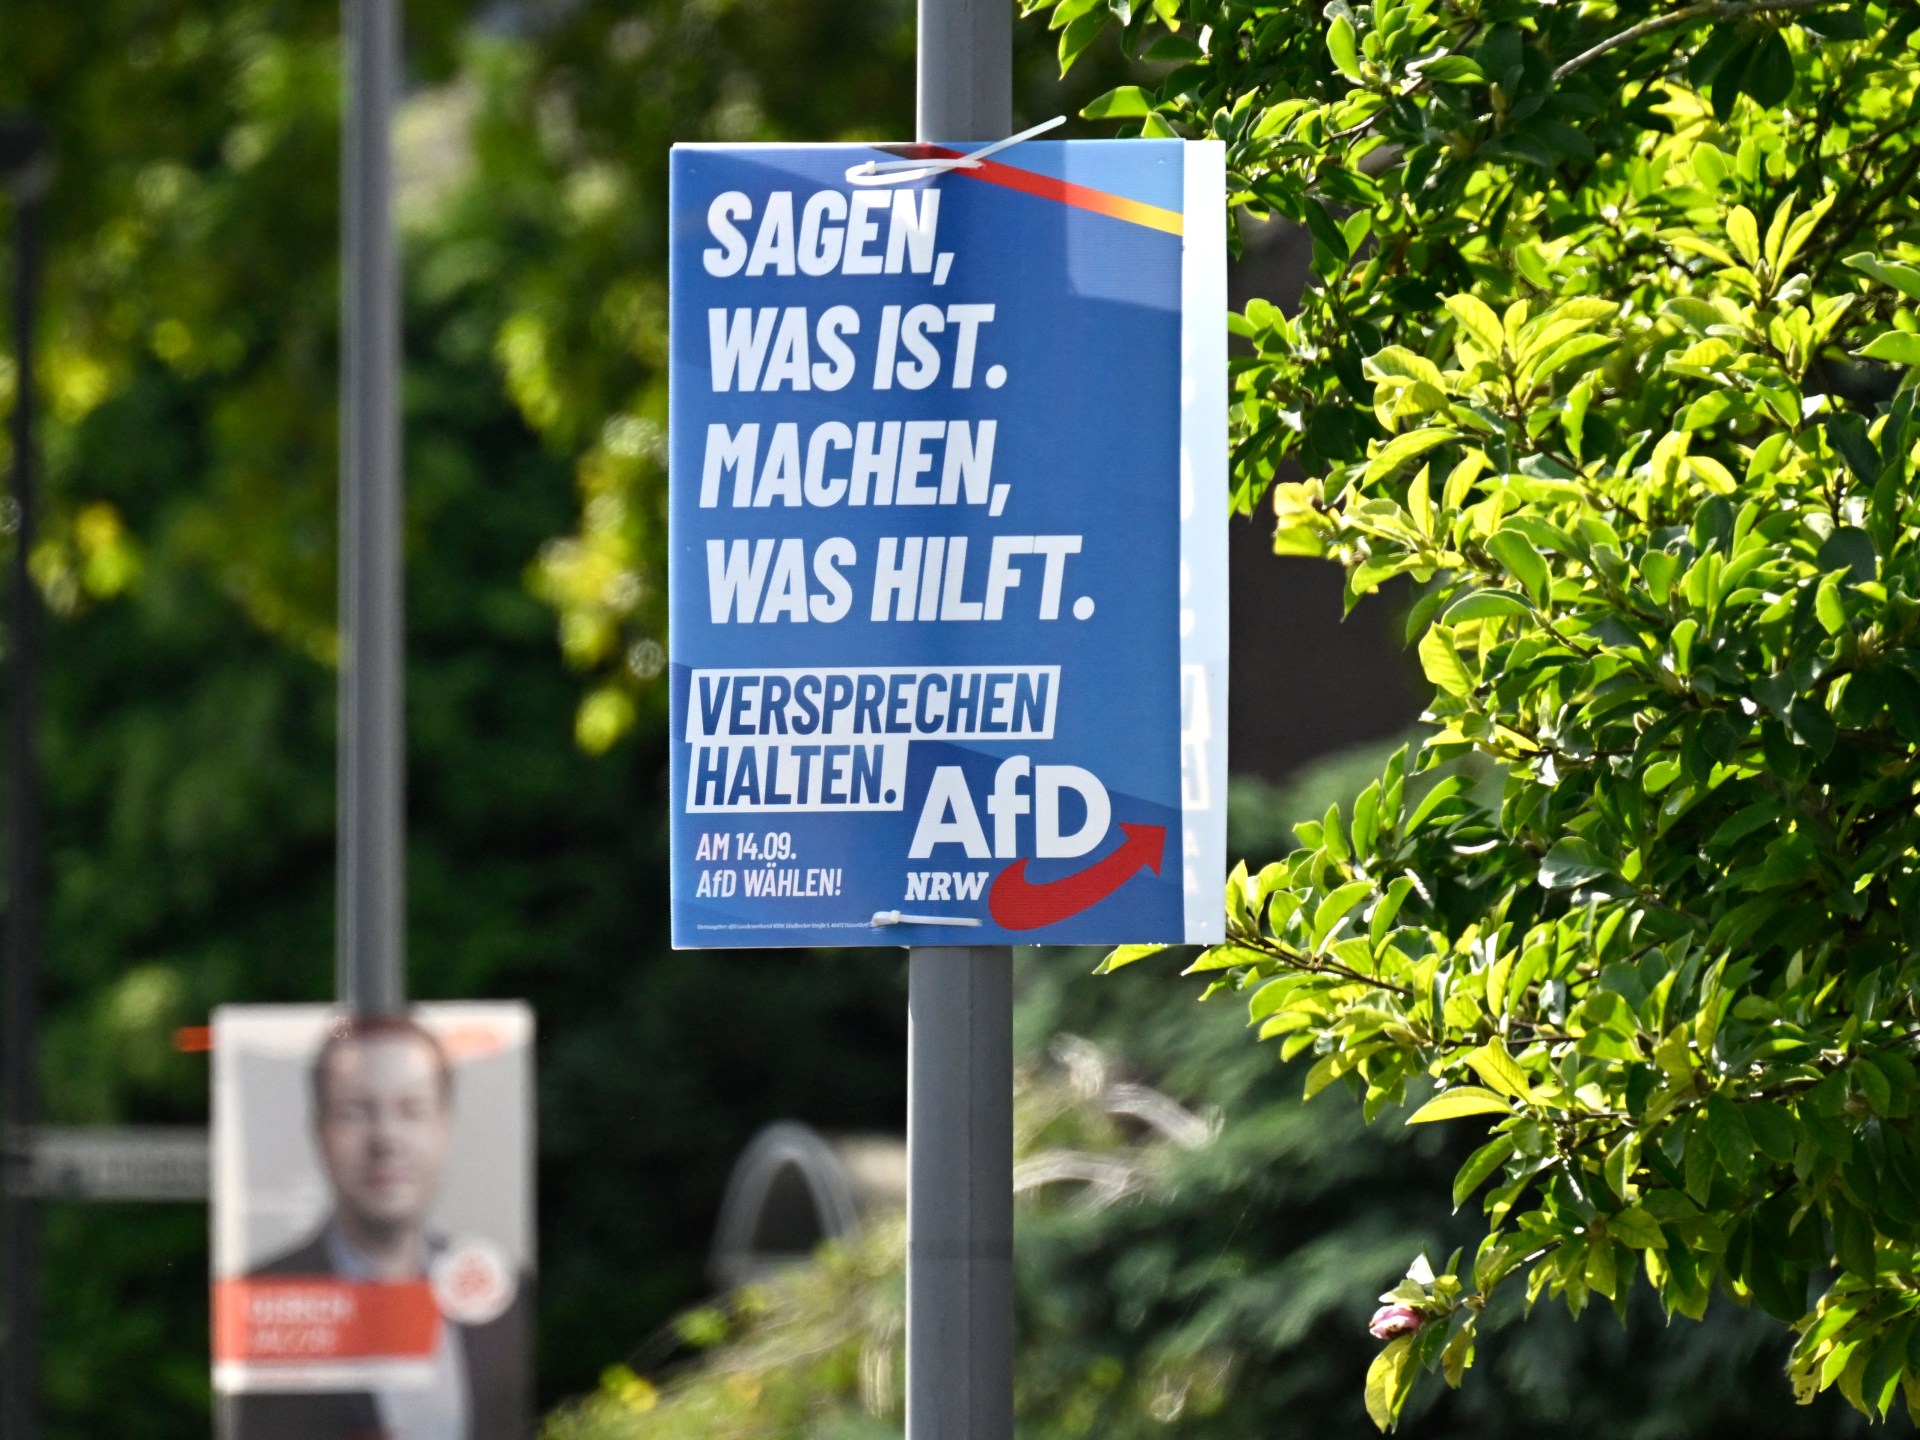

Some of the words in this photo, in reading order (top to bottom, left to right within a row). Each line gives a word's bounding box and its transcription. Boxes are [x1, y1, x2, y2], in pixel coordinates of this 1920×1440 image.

[703, 188, 954, 285] SAGEN,
[709, 306, 860, 392] WAS
[873, 304, 1007, 389] IST.
[700, 420, 1010, 516] MACHEN,
[707, 537, 856, 623] WAS
[871, 535, 1094, 621] HILFT.
[698, 673, 1050, 736] VERSPRECHEN
[695, 744, 897, 806] HALTEN.
[908, 755, 1111, 859] AfD
[695, 833, 730, 861] AM
[736, 832, 797, 861] 14.09.
[695, 869, 736, 898] AfD
[743, 862, 842, 897] WÄHLEN!
[904, 872, 989, 901] NRW
